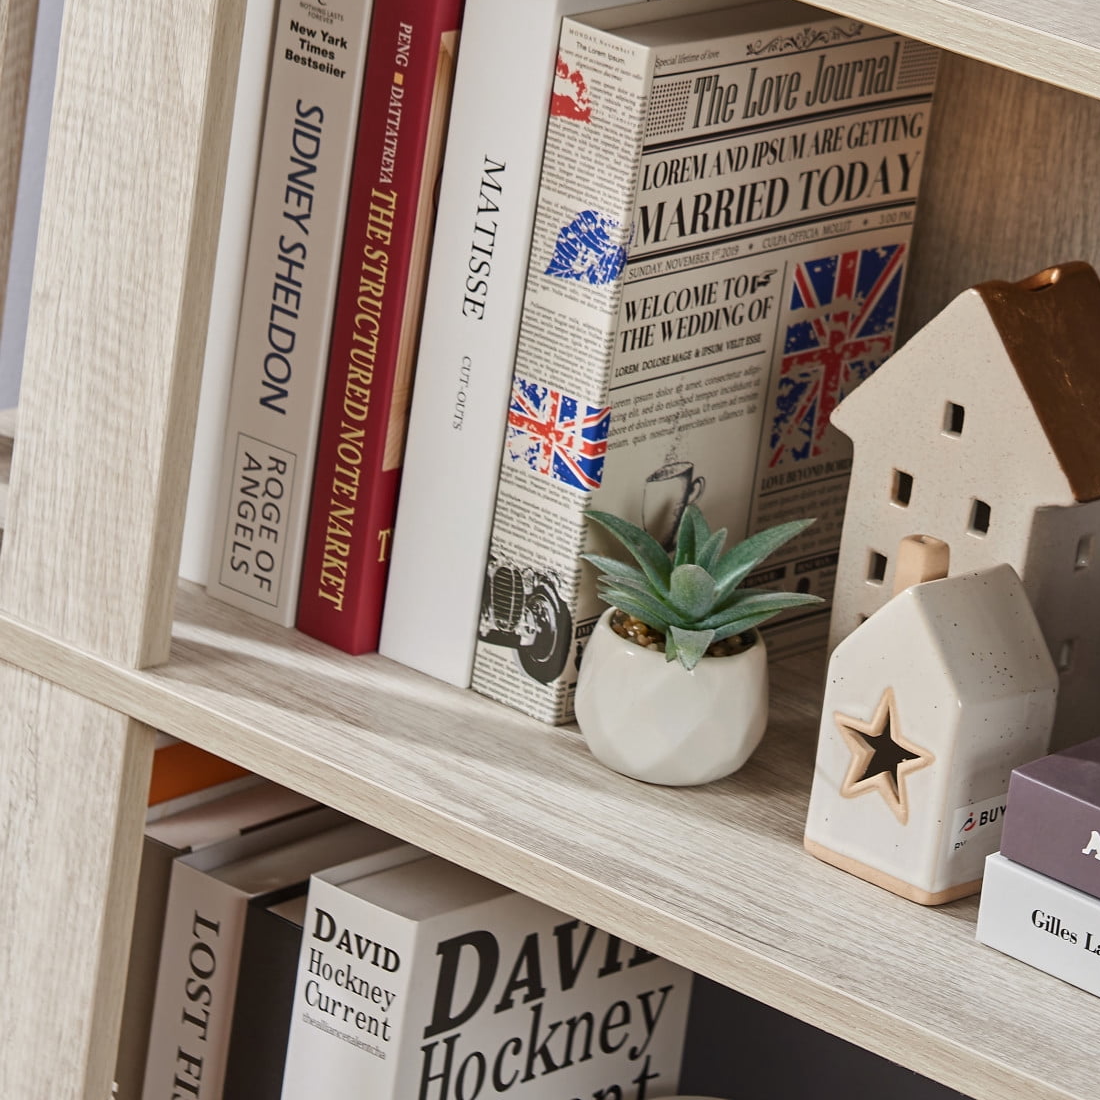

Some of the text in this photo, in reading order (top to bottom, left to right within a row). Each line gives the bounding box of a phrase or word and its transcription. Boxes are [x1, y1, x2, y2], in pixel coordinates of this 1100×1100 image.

[290, 20, 317, 38] New
[299, 38, 336, 60] Times
[395, 21, 413, 68] PENG
[691, 41, 900, 130] The Love Journal
[378, 84, 404, 185] DATTATREYA
[641, 111, 924, 192] LOREM AND IPSUM ARE GETTING
[363, 188, 397, 243] THE
[633, 150, 922, 249] MARRIED TODAY
[259, 98, 324, 415] SIDNEY SHELDON
[462, 155, 506, 321] MATISSE
[664, 254, 711, 274] NOVEMBER
[720, 246, 740, 260] 2019
[762, 220, 852, 250] CULPA OFFICIA MOLLIT
[619, 295, 773, 353] THE WEDDING OF
[624, 274, 751, 324] WELCOME TO
[342, 245, 388, 422] STRUCTURED
[615, 364, 639, 378] LOREM
[641, 354, 671, 371] DOLORE
[701, 342, 724, 357] IPSUM
[452, 355, 473, 431] CUT-OUTS
[331, 423, 366, 505] NOTE
[230, 451, 262, 575] ANGELS
[252, 547, 275, 593] OF
[312, 907, 400, 974] DAVID
[1031, 908, 1078, 946] Gilles
[181, 909, 221, 1042] LOST
[307, 948, 397, 1013] Hockney
[304, 980, 392, 1043] Current
[418, 984, 674, 1100] Hockney
